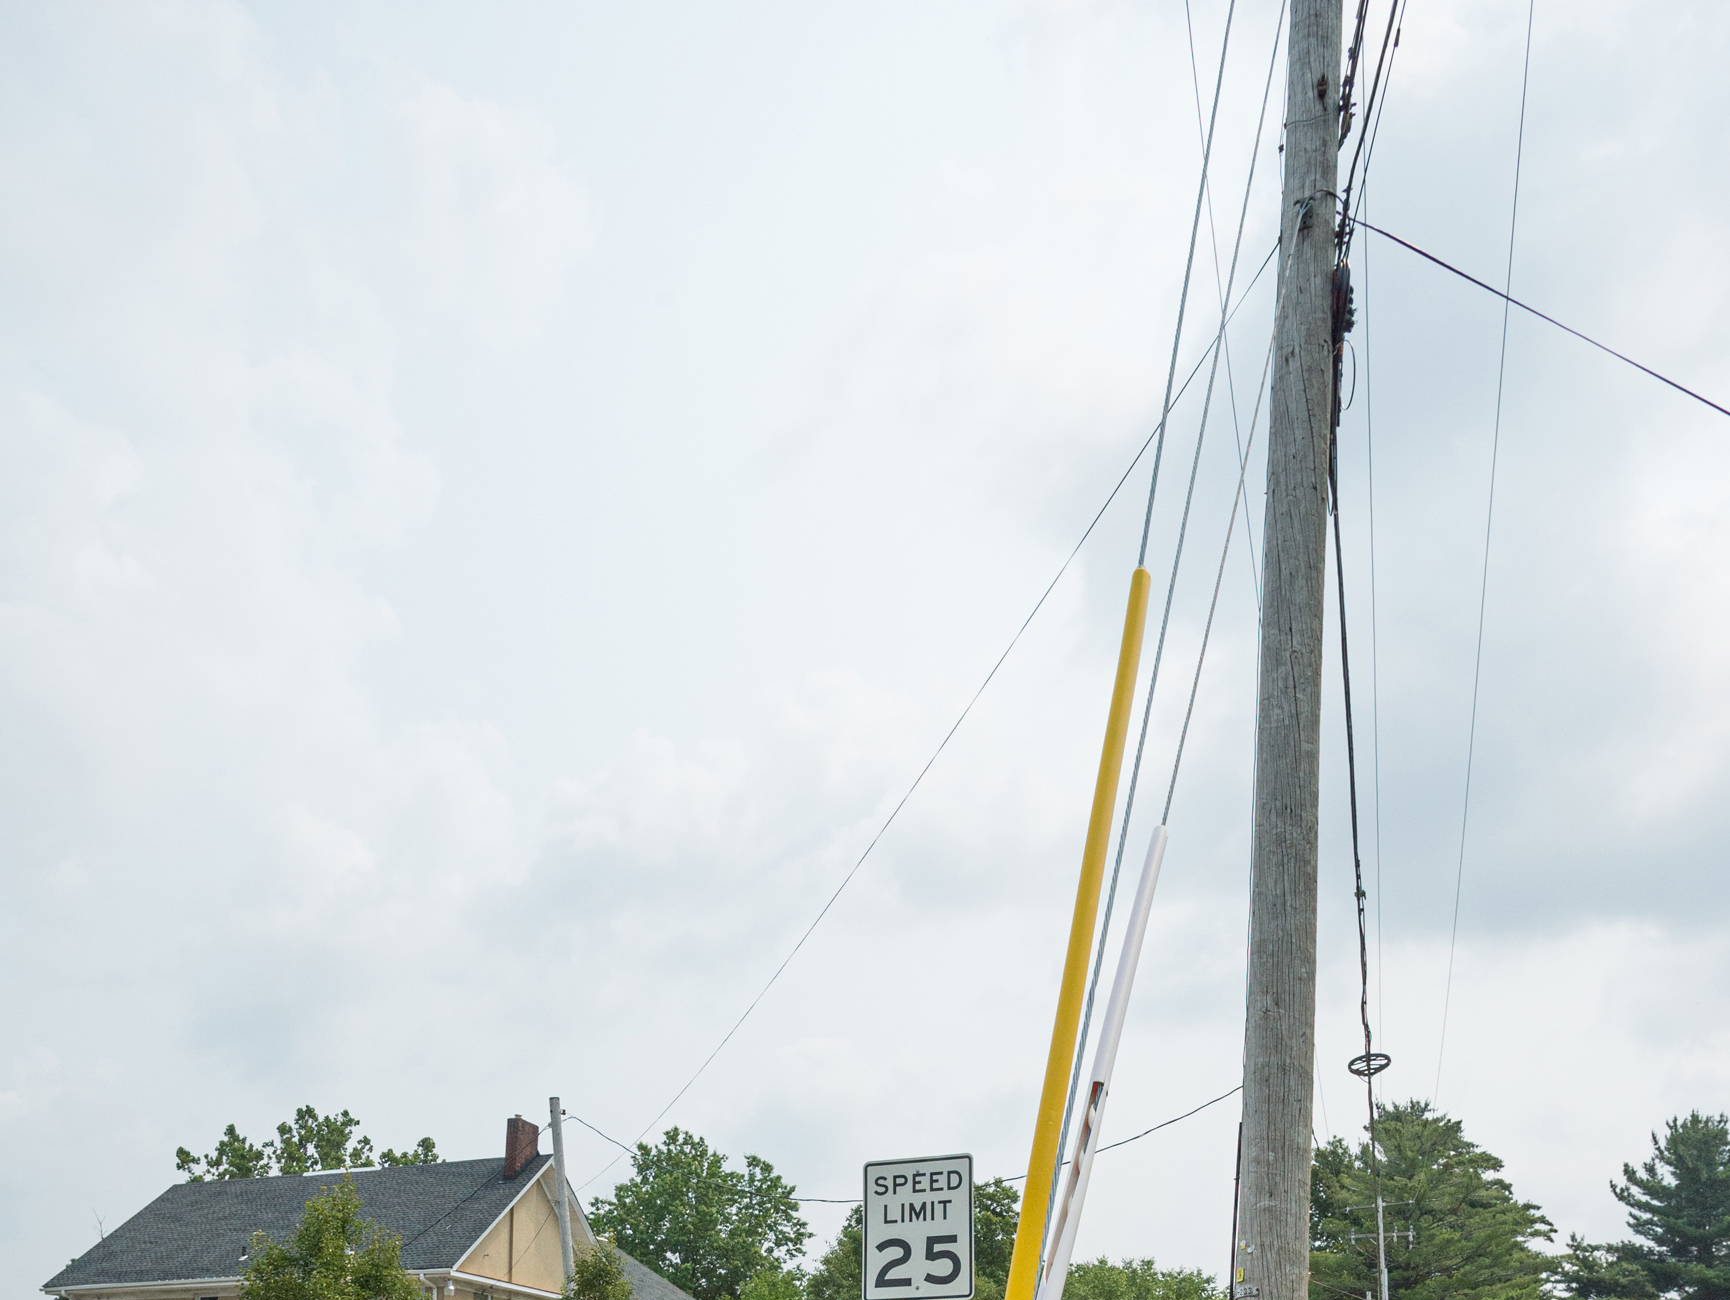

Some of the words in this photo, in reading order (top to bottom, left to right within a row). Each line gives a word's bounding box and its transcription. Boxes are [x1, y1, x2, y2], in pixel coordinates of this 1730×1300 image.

[874, 1170, 963, 1196] SPEED
[884, 1200, 952, 1224] LIMIT
[874, 1234, 962, 1288] 25
